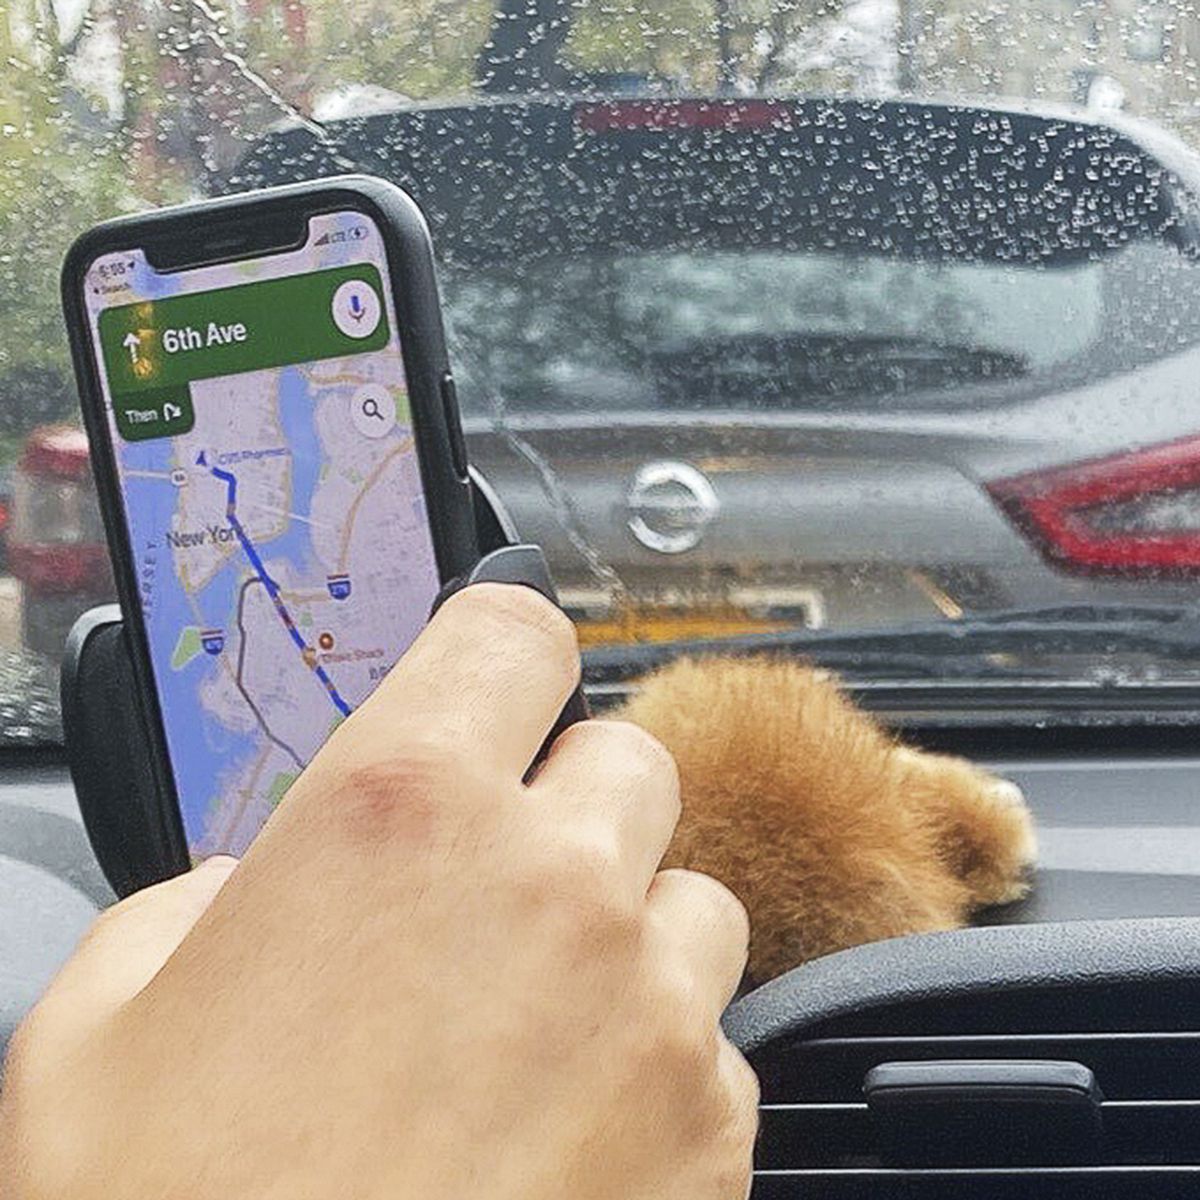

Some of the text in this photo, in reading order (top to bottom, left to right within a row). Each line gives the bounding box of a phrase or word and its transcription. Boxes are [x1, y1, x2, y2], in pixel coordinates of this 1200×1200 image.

[163, 322, 247, 353] 6th Ave
[125, 409, 159, 425] Then
[166, 530, 204, 548] New
